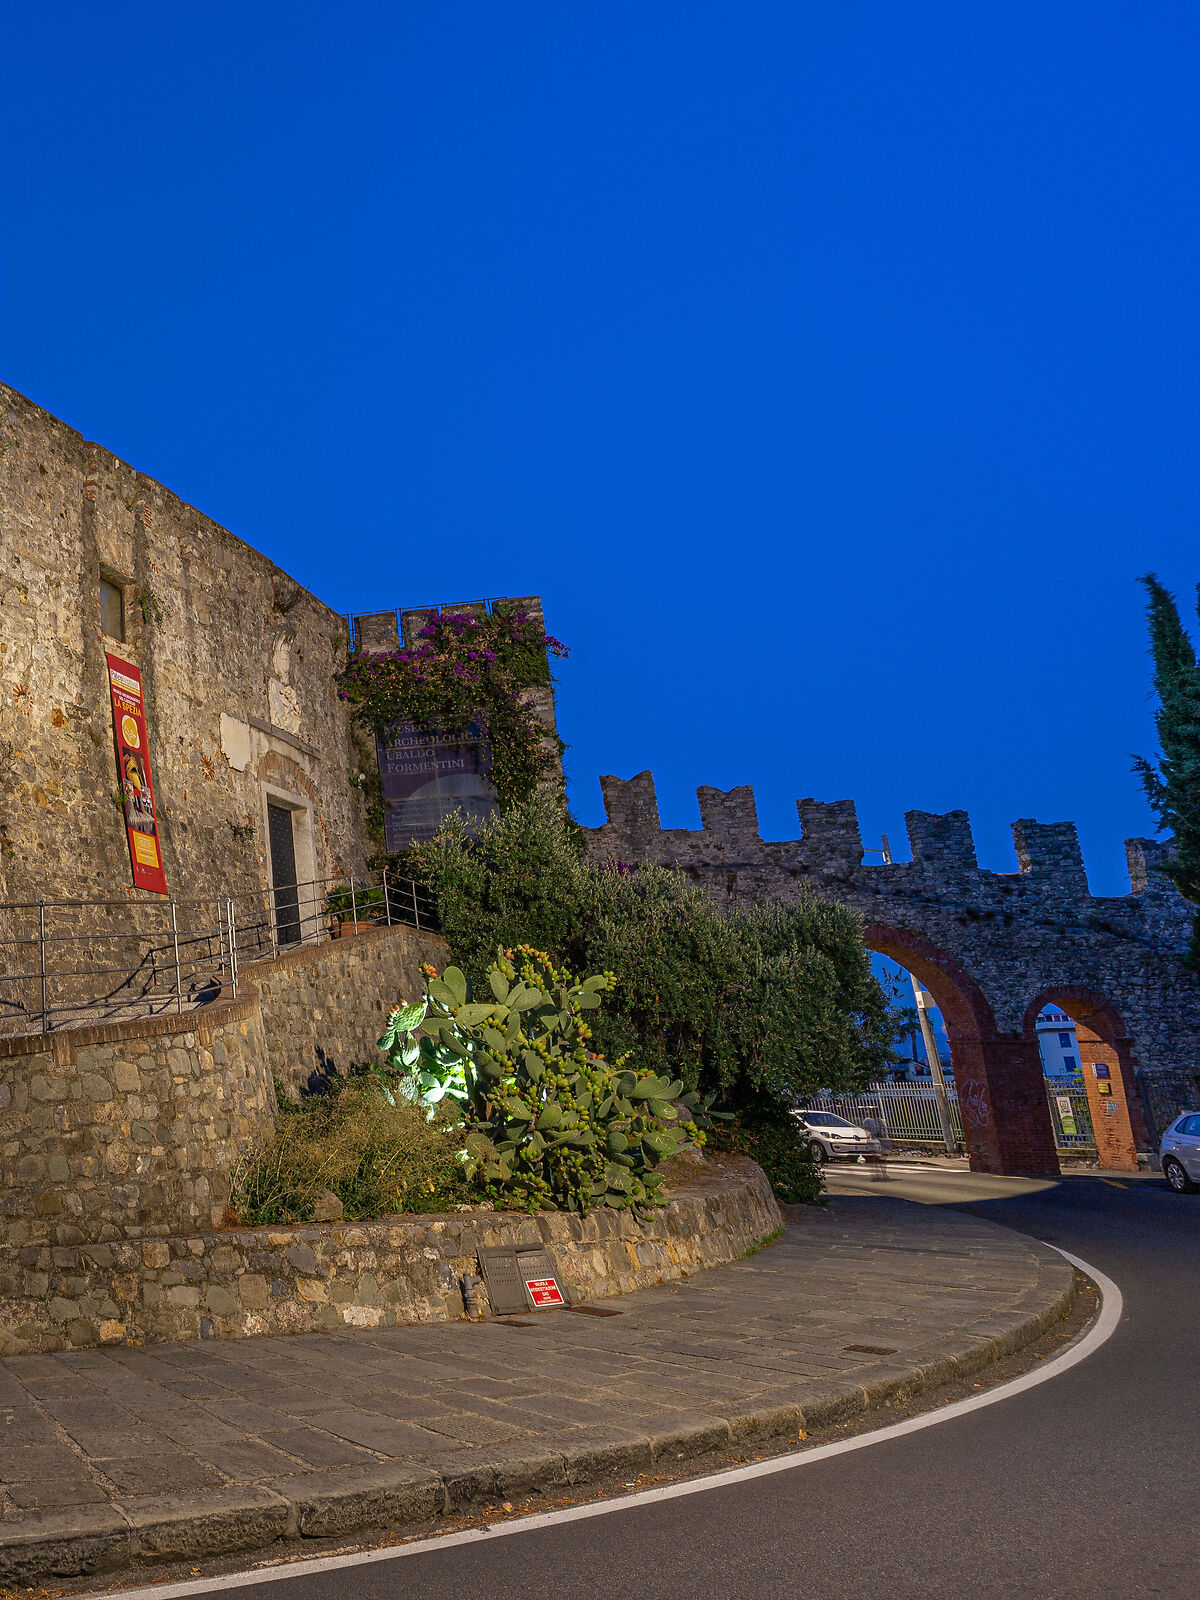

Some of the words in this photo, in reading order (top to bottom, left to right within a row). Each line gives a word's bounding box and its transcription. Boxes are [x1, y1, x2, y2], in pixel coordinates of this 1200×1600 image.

[113, 697, 122, 709] LA
[121, 701, 143, 718] SPEZIA
[386, 749, 435, 761] UBALDO
[387, 759, 465, 773] FORMENTINI
